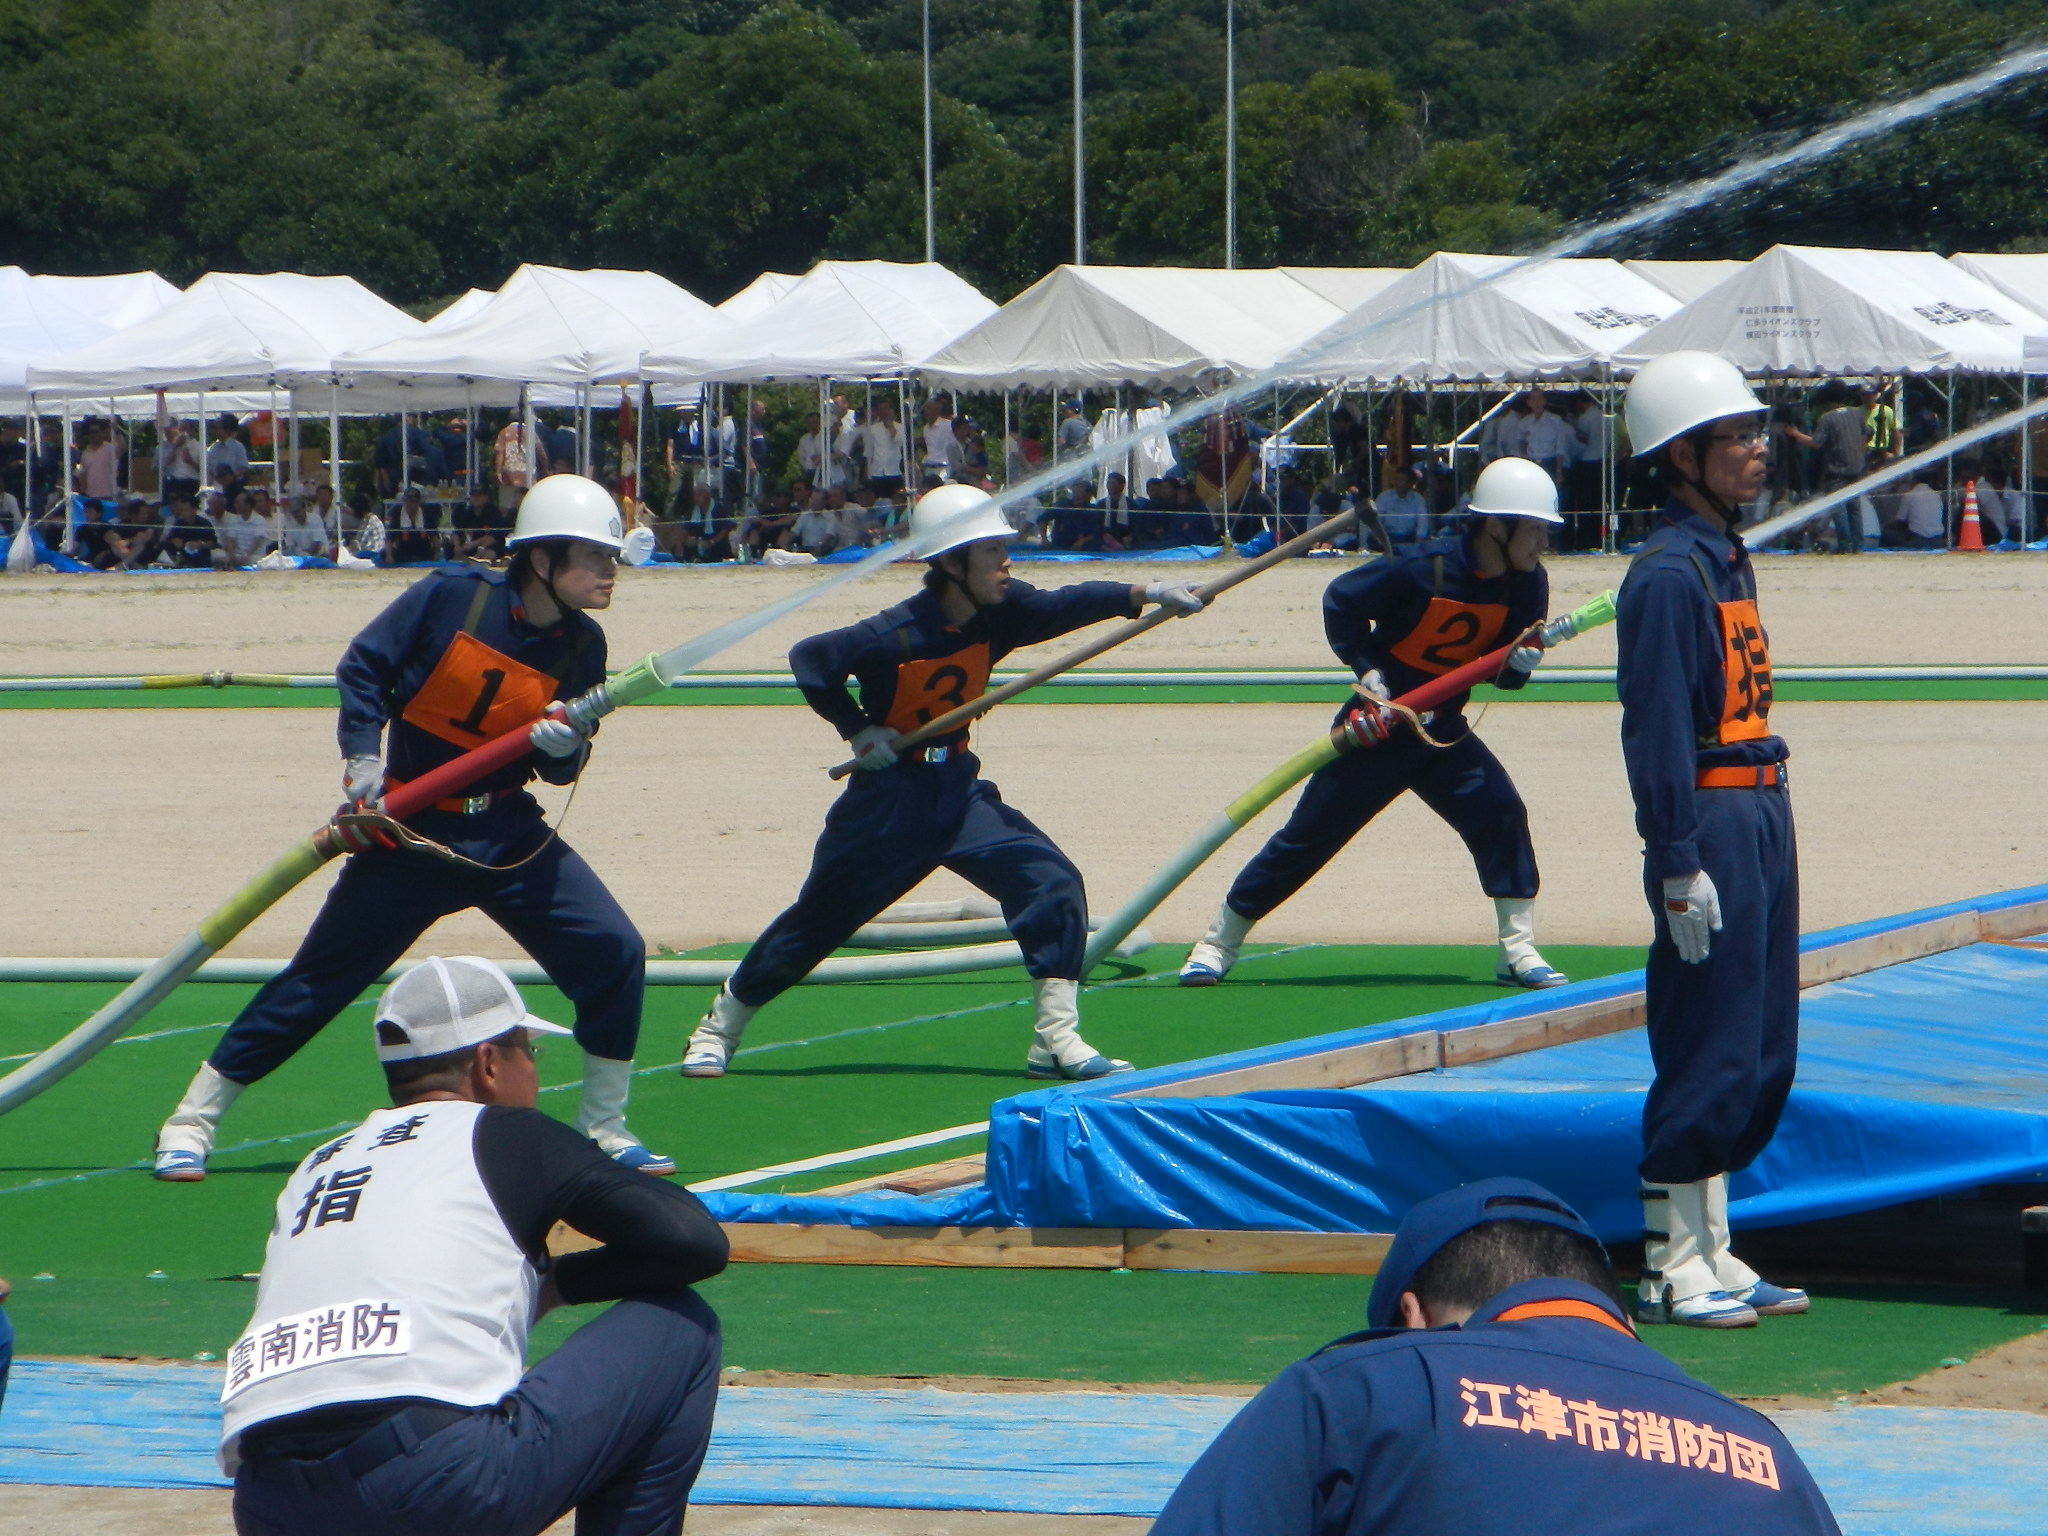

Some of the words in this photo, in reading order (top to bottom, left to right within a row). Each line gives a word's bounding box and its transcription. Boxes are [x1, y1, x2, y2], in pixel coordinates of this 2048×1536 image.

[1745, 318, 1821, 327] 仁多ライオンズクラブ
[1420, 611, 1480, 668] 2
[1730, 620, 1773, 722] 指
[448, 667, 506, 738] 1
[915, 664, 968, 726] 3
[290, 1165, 373, 1238] 指
[229, 1301, 401, 1391] 雲南消防
[1458, 1376, 1782, 1491] 江津市消防団
